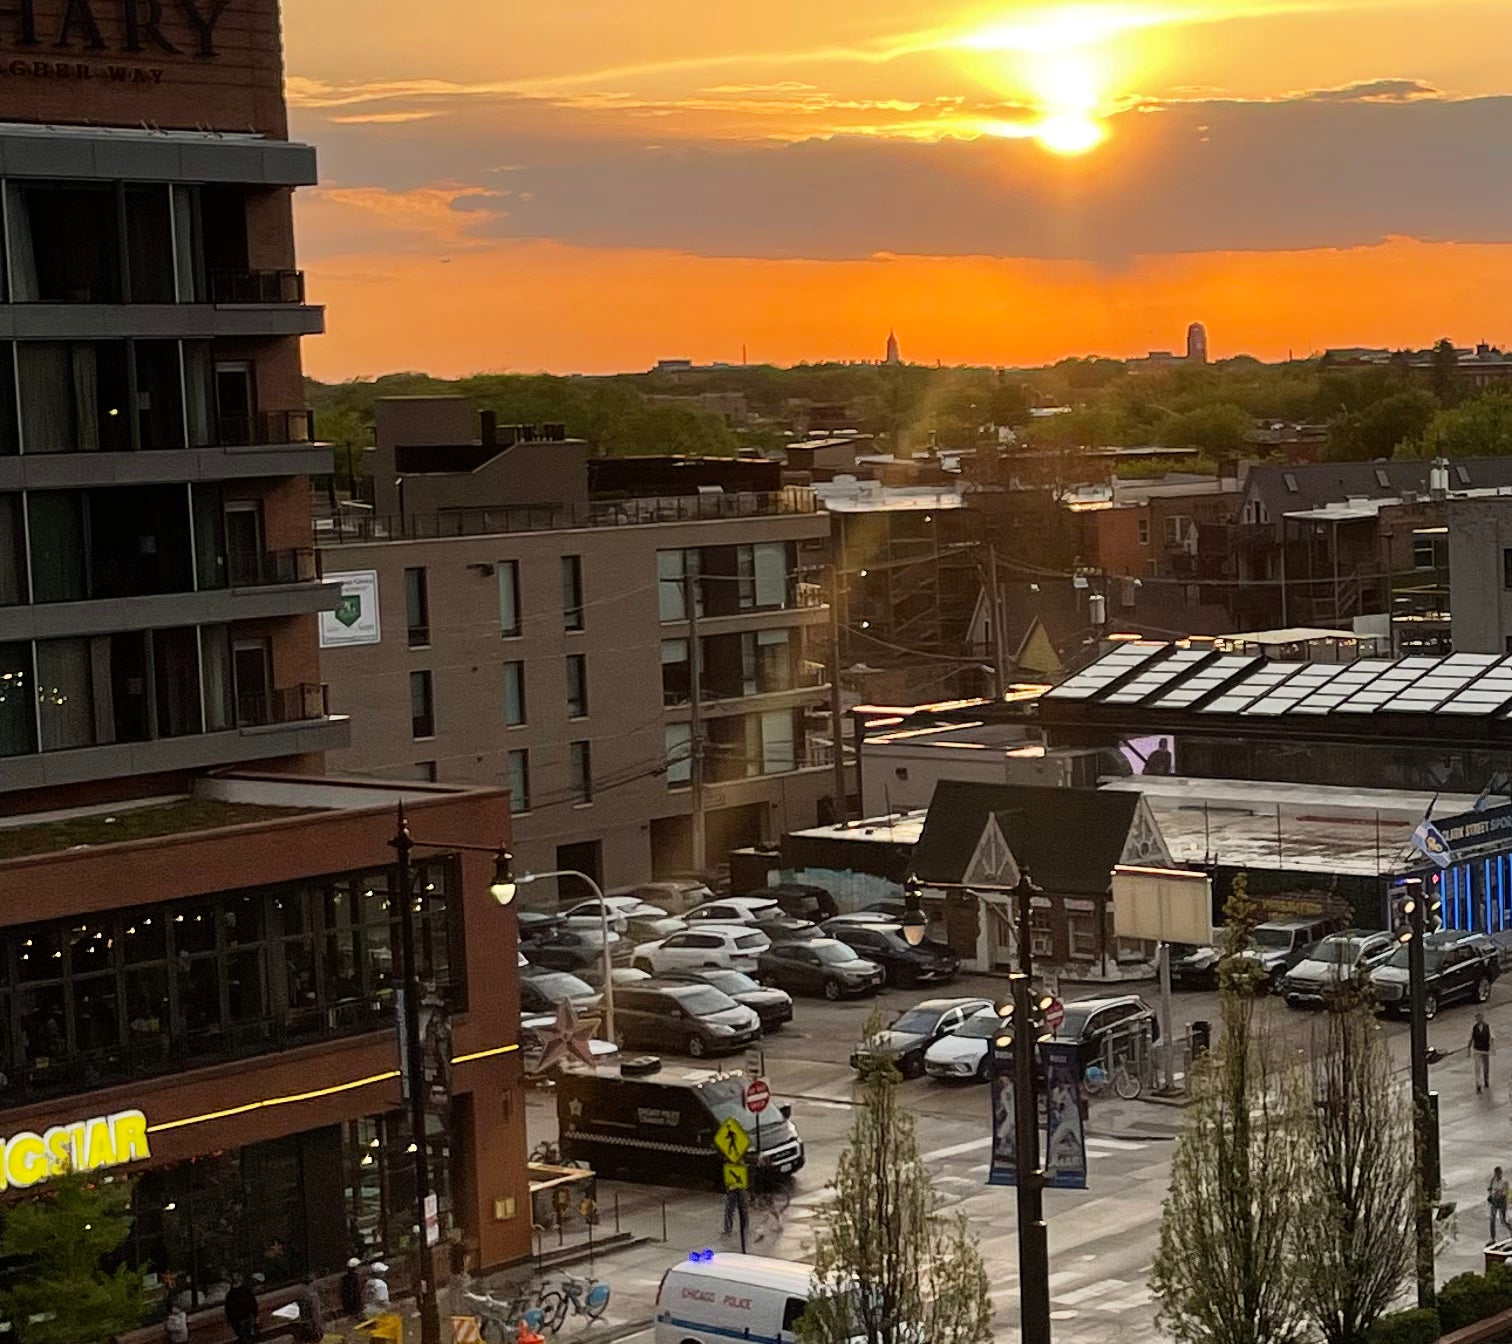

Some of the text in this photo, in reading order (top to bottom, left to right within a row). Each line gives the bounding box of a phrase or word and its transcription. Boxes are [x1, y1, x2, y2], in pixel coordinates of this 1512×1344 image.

[105, 65, 164, 84] WAY
[0, 1109, 151, 1193] GSTAR
[724, 1295, 753, 1310] POLICE
